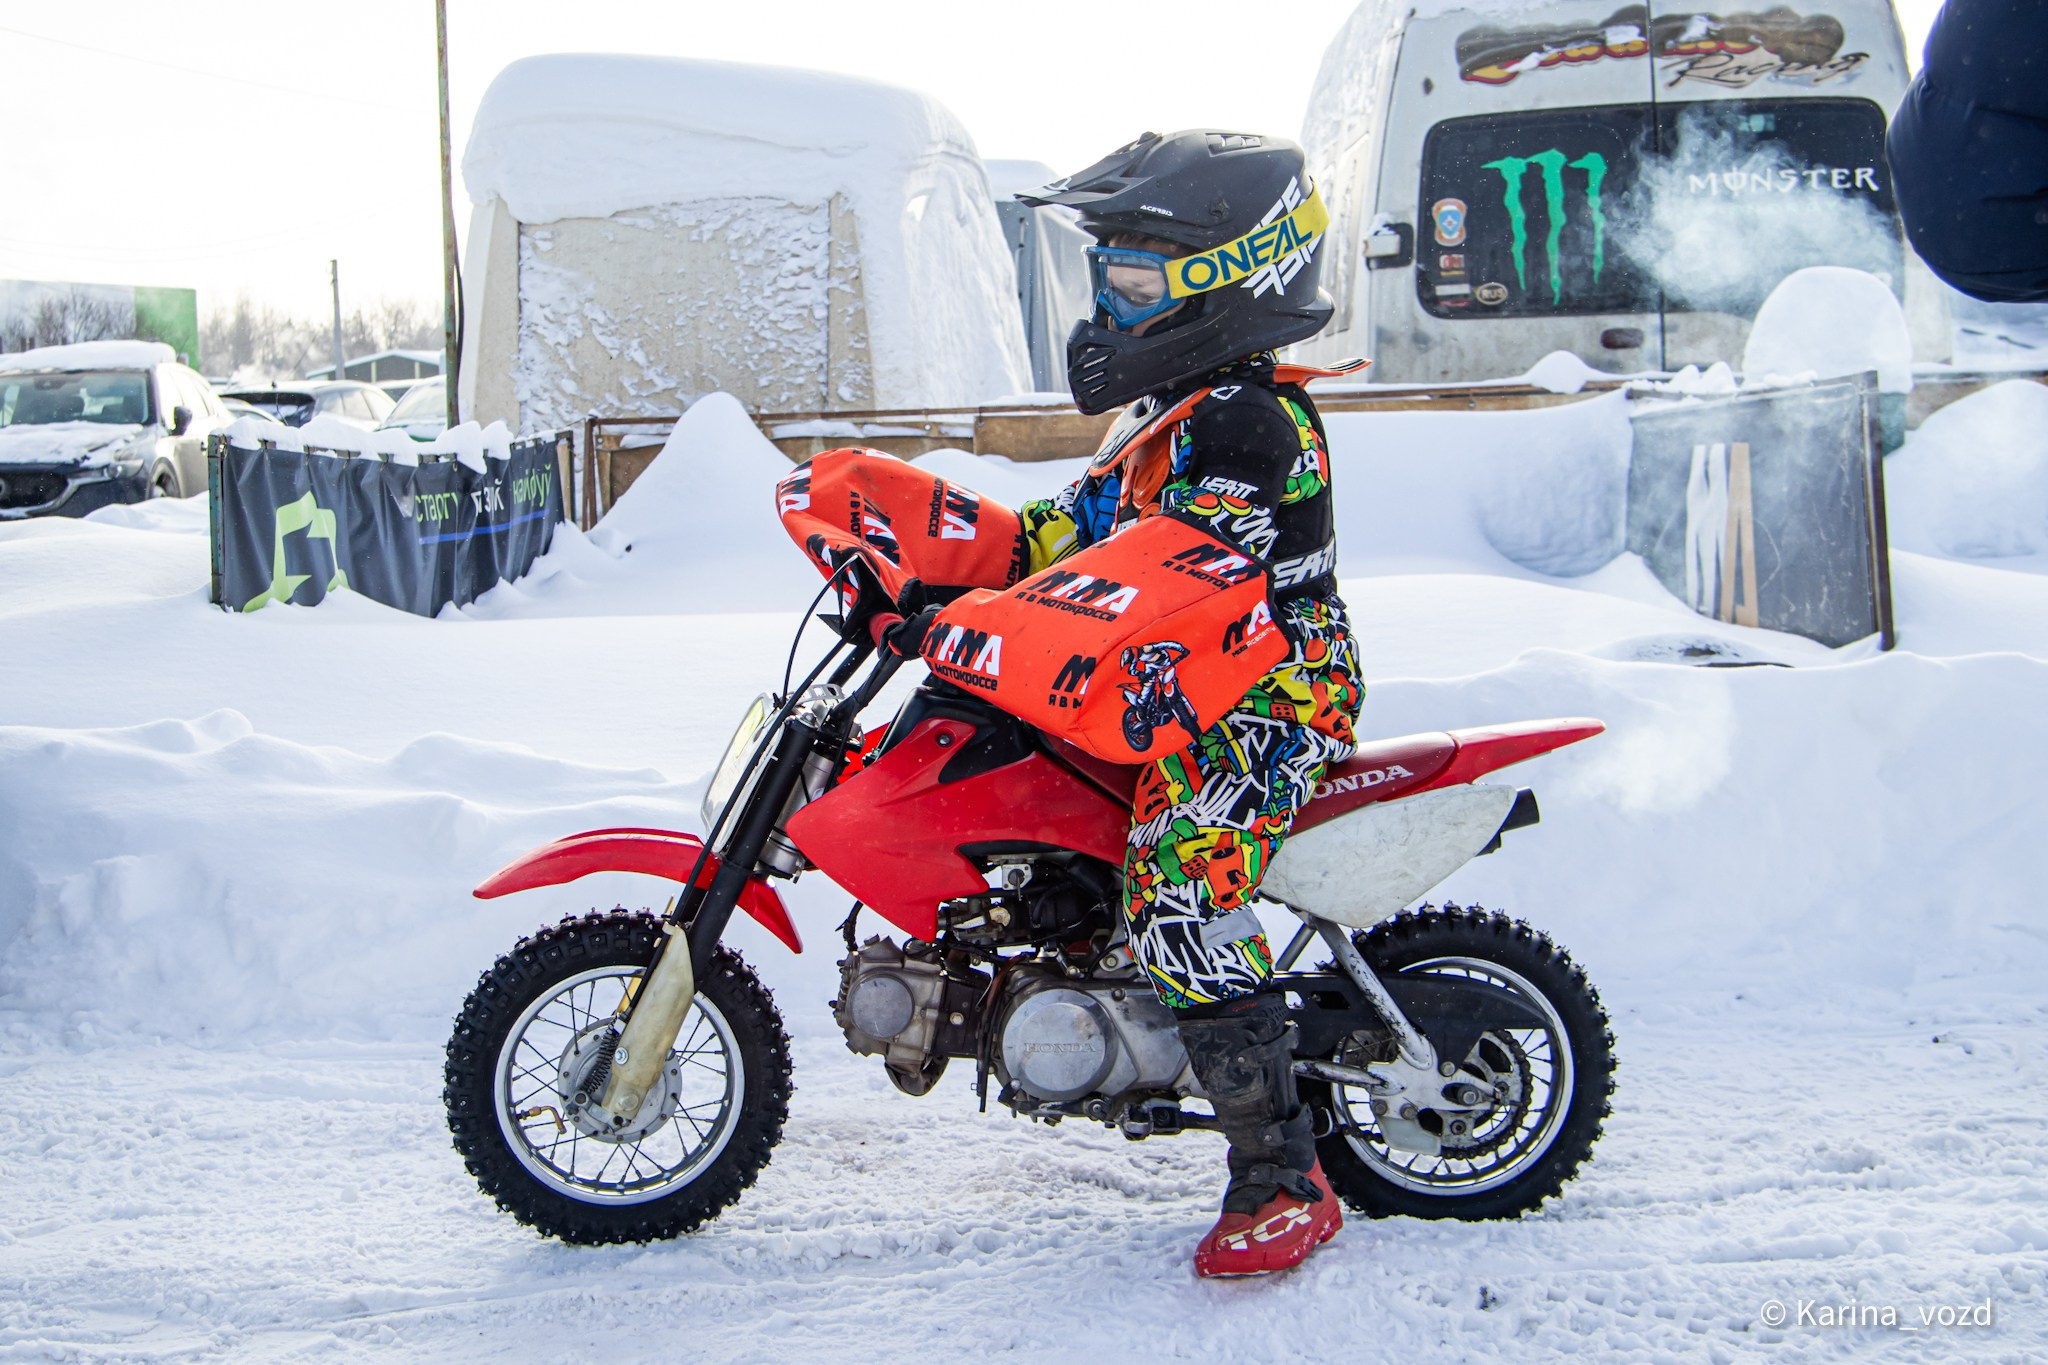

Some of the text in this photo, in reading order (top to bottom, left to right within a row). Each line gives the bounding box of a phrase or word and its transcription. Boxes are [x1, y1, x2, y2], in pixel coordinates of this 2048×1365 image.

[1689, 166, 1881, 197] MONSTER
[1140, 204, 1174, 217] ACERBIS
[1311, 764, 1415, 800] ONDA
[1023, 1042, 1098, 1054] HONDA
[1219, 1203, 1313, 1250] TCX
